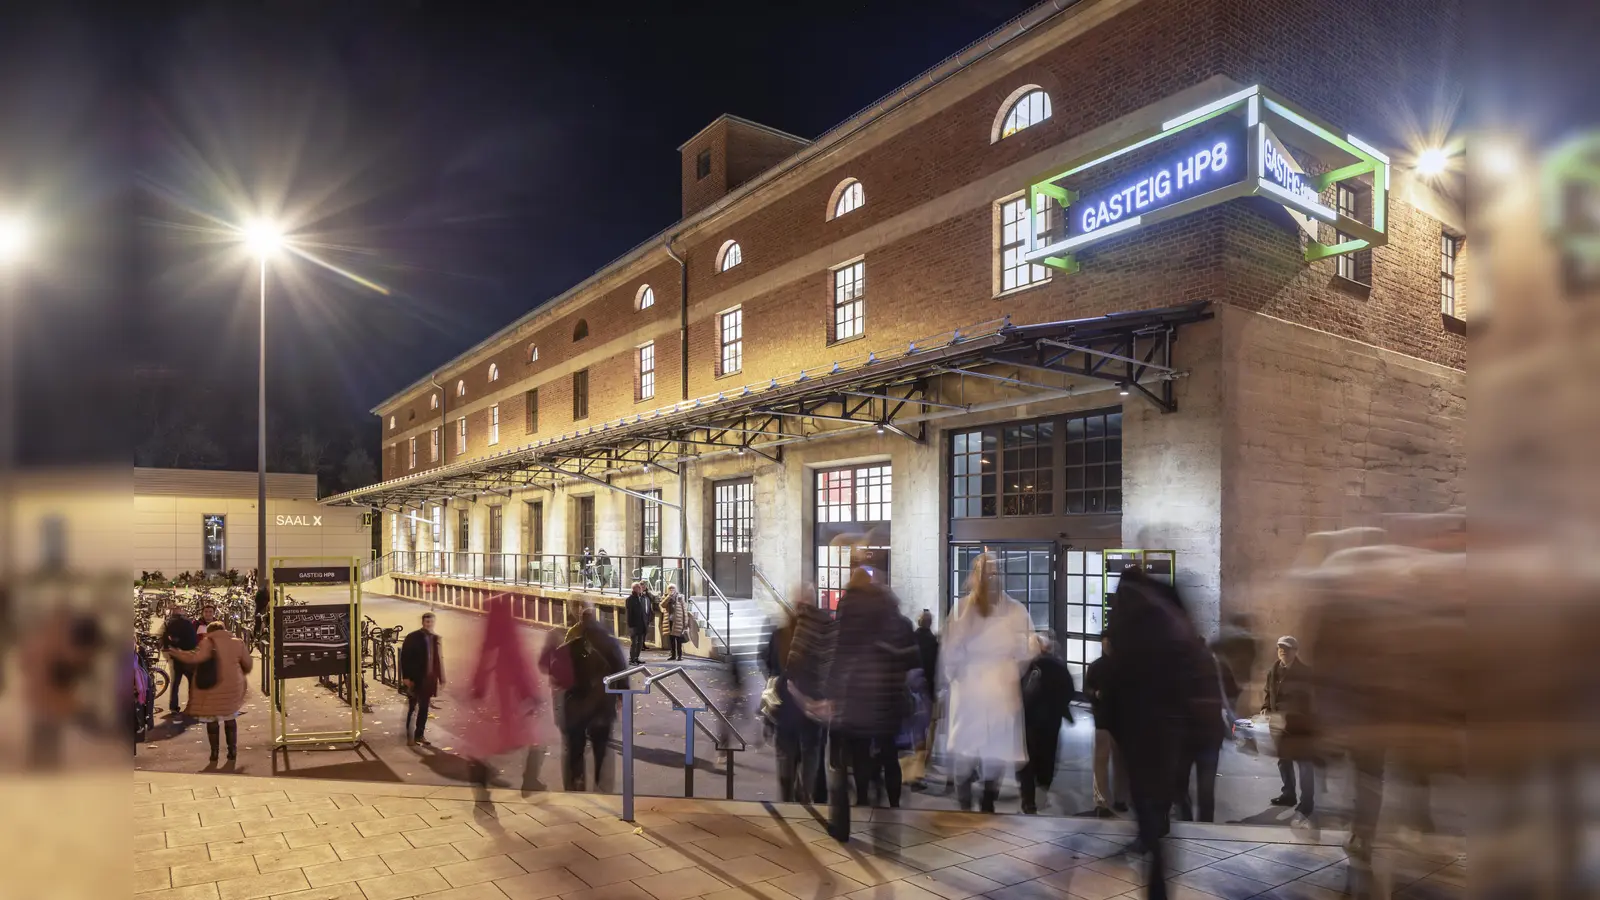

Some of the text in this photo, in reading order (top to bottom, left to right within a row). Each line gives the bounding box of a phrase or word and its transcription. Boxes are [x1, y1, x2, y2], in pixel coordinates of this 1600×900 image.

[1082, 141, 1228, 233] GASTEIG HP8
[276, 515, 322, 526] SAAL X
